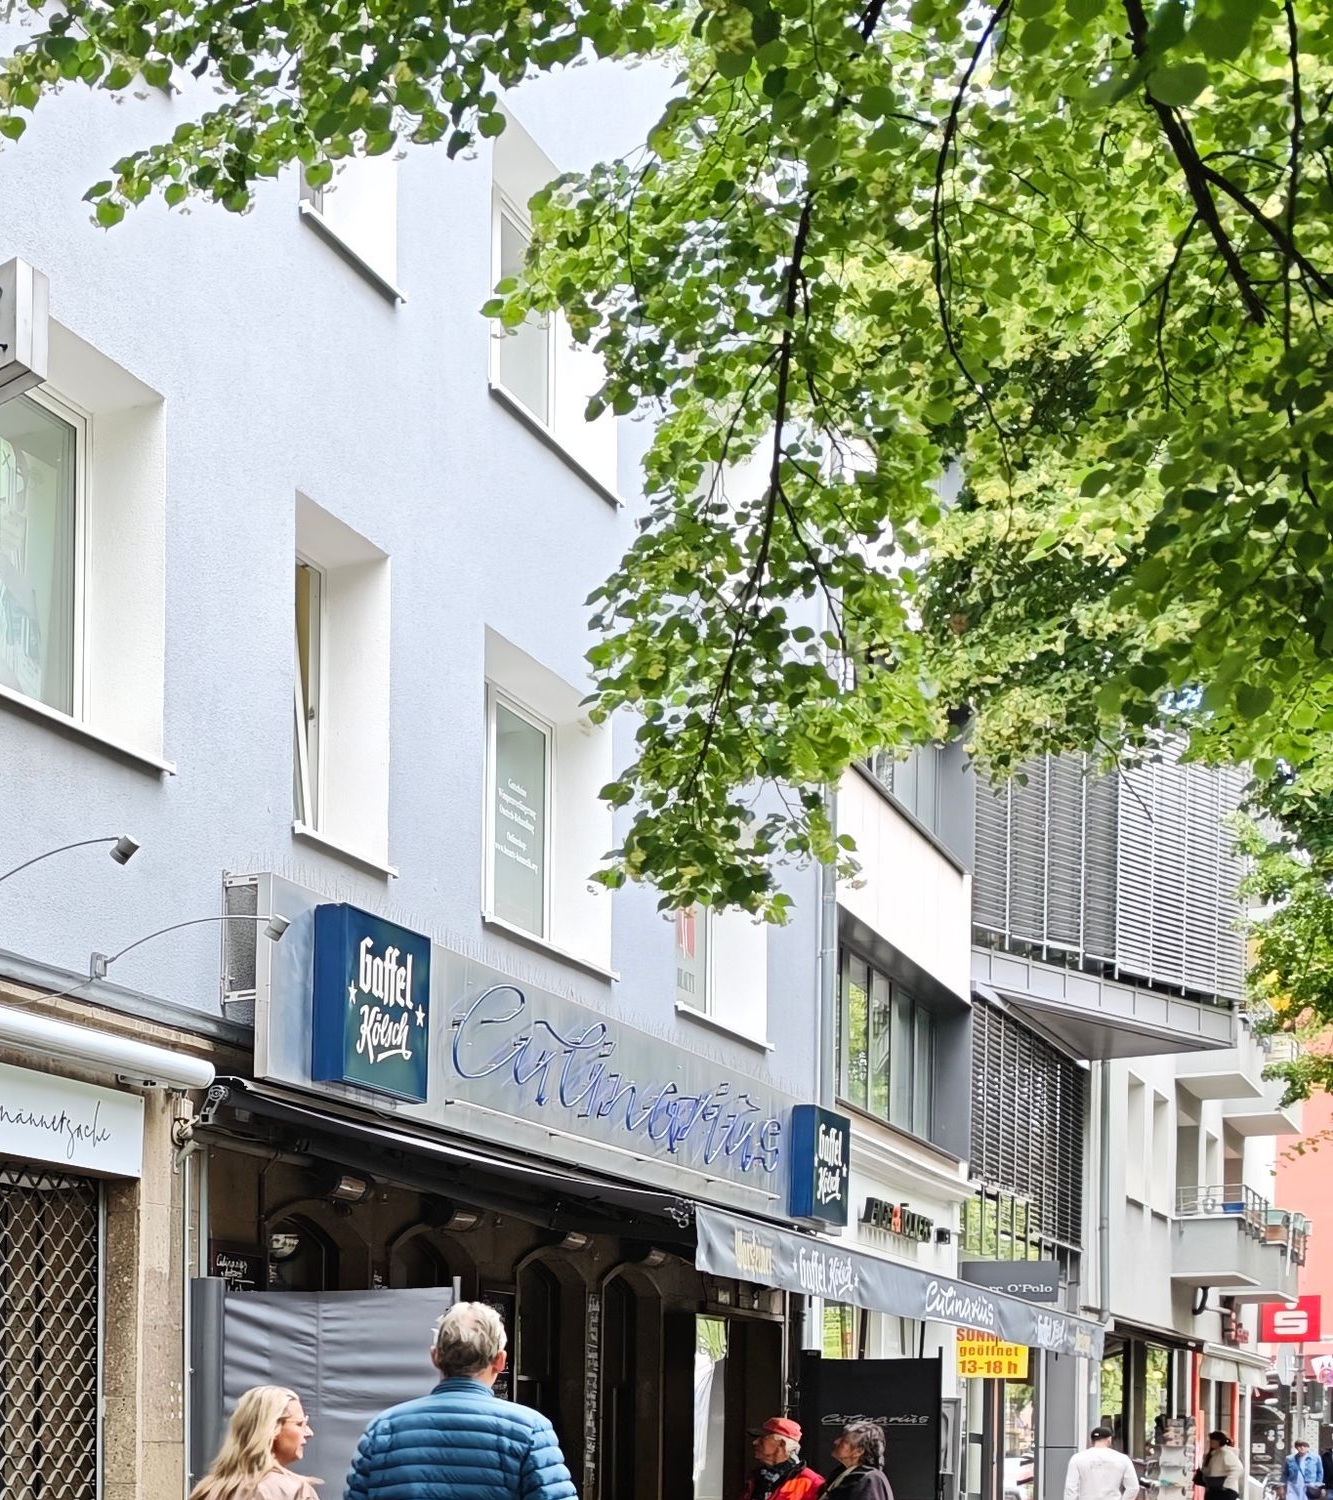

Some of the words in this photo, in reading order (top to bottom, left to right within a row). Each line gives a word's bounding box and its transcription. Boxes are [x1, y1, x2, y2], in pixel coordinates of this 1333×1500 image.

[359, 936, 413, 1010] Gaffel
[356, 1004, 412, 1064] Kölsch
[925, 1280, 994, 1326] Culinarius
[1007, 1284, 1053, 1293] O'Polo
[960, 1345, 1018, 1357] geöffnet
[959, 1360, 1003, 1374] 13-18
[1008, 1361, 1018, 1374] h
